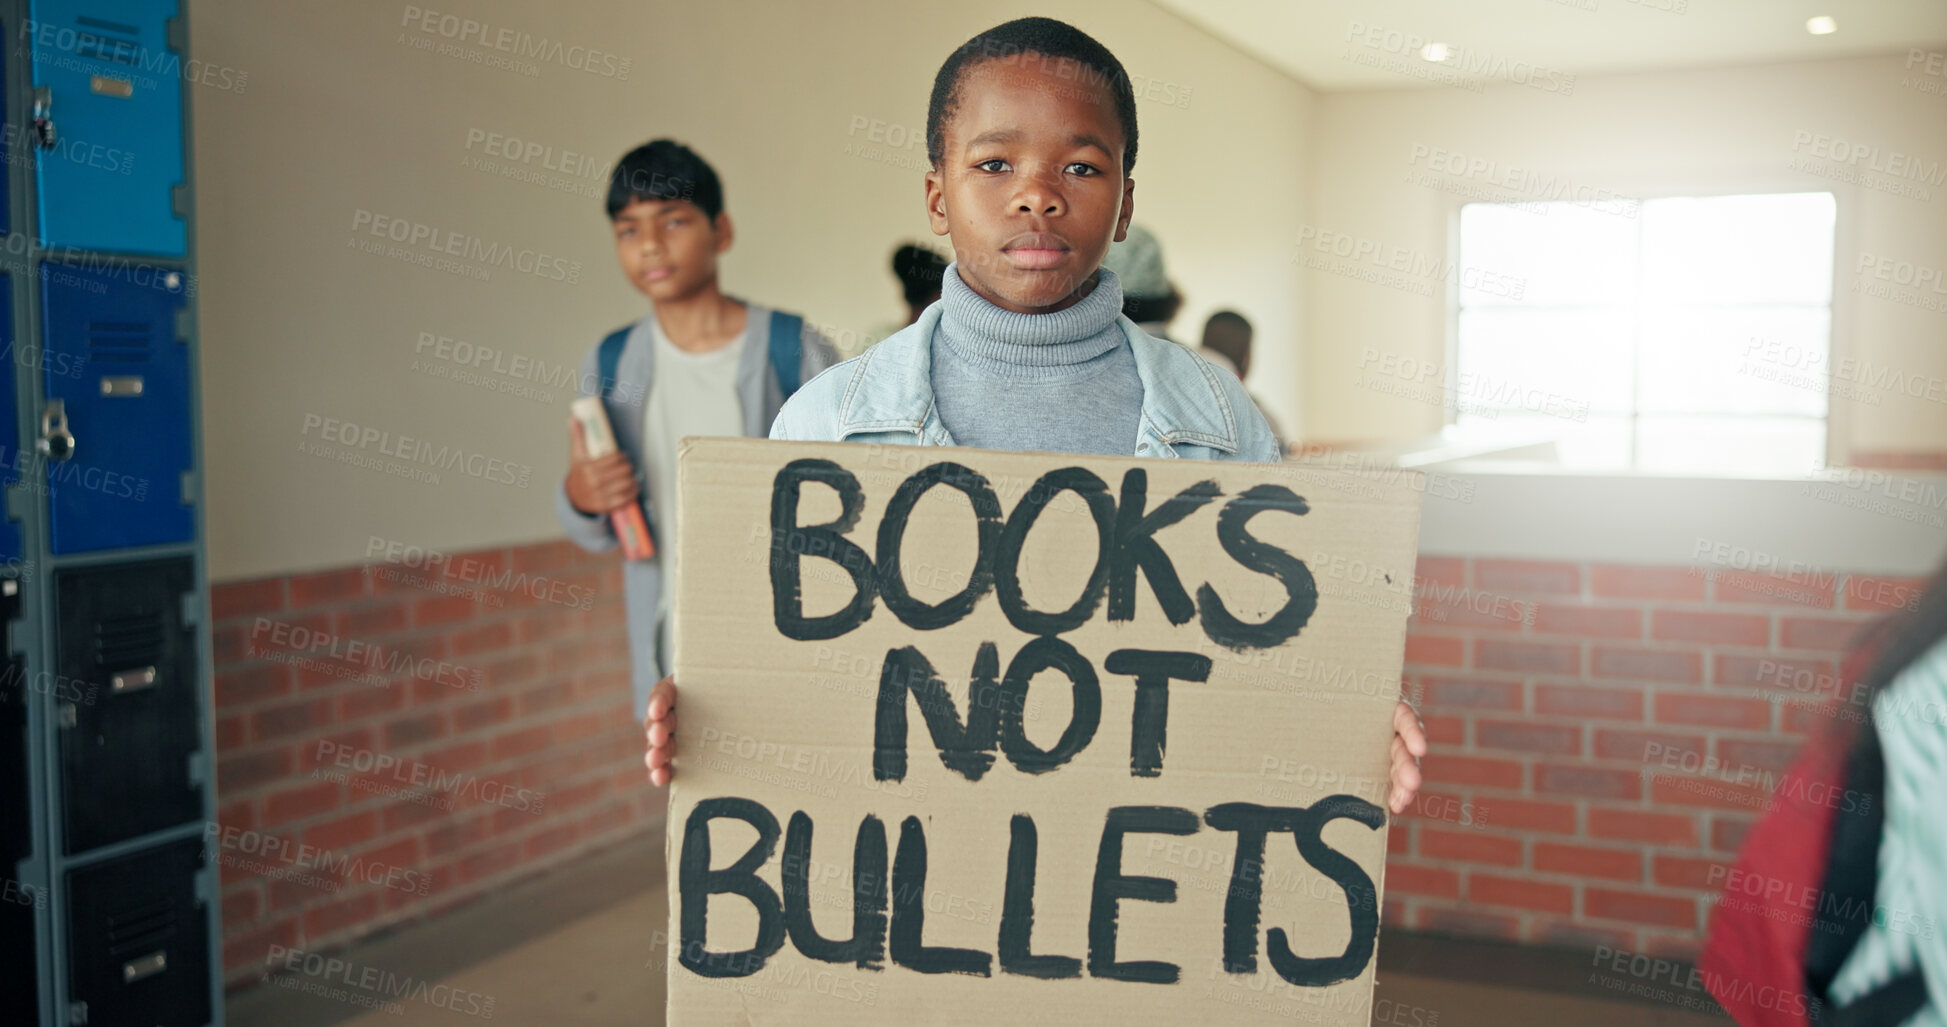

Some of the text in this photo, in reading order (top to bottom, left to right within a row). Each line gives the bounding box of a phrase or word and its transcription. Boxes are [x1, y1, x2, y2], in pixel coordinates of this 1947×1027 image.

[769, 458, 1318, 652] BOOKS
[873, 634, 1212, 783] NOT
[678, 793, 1386, 987] BULLETS
